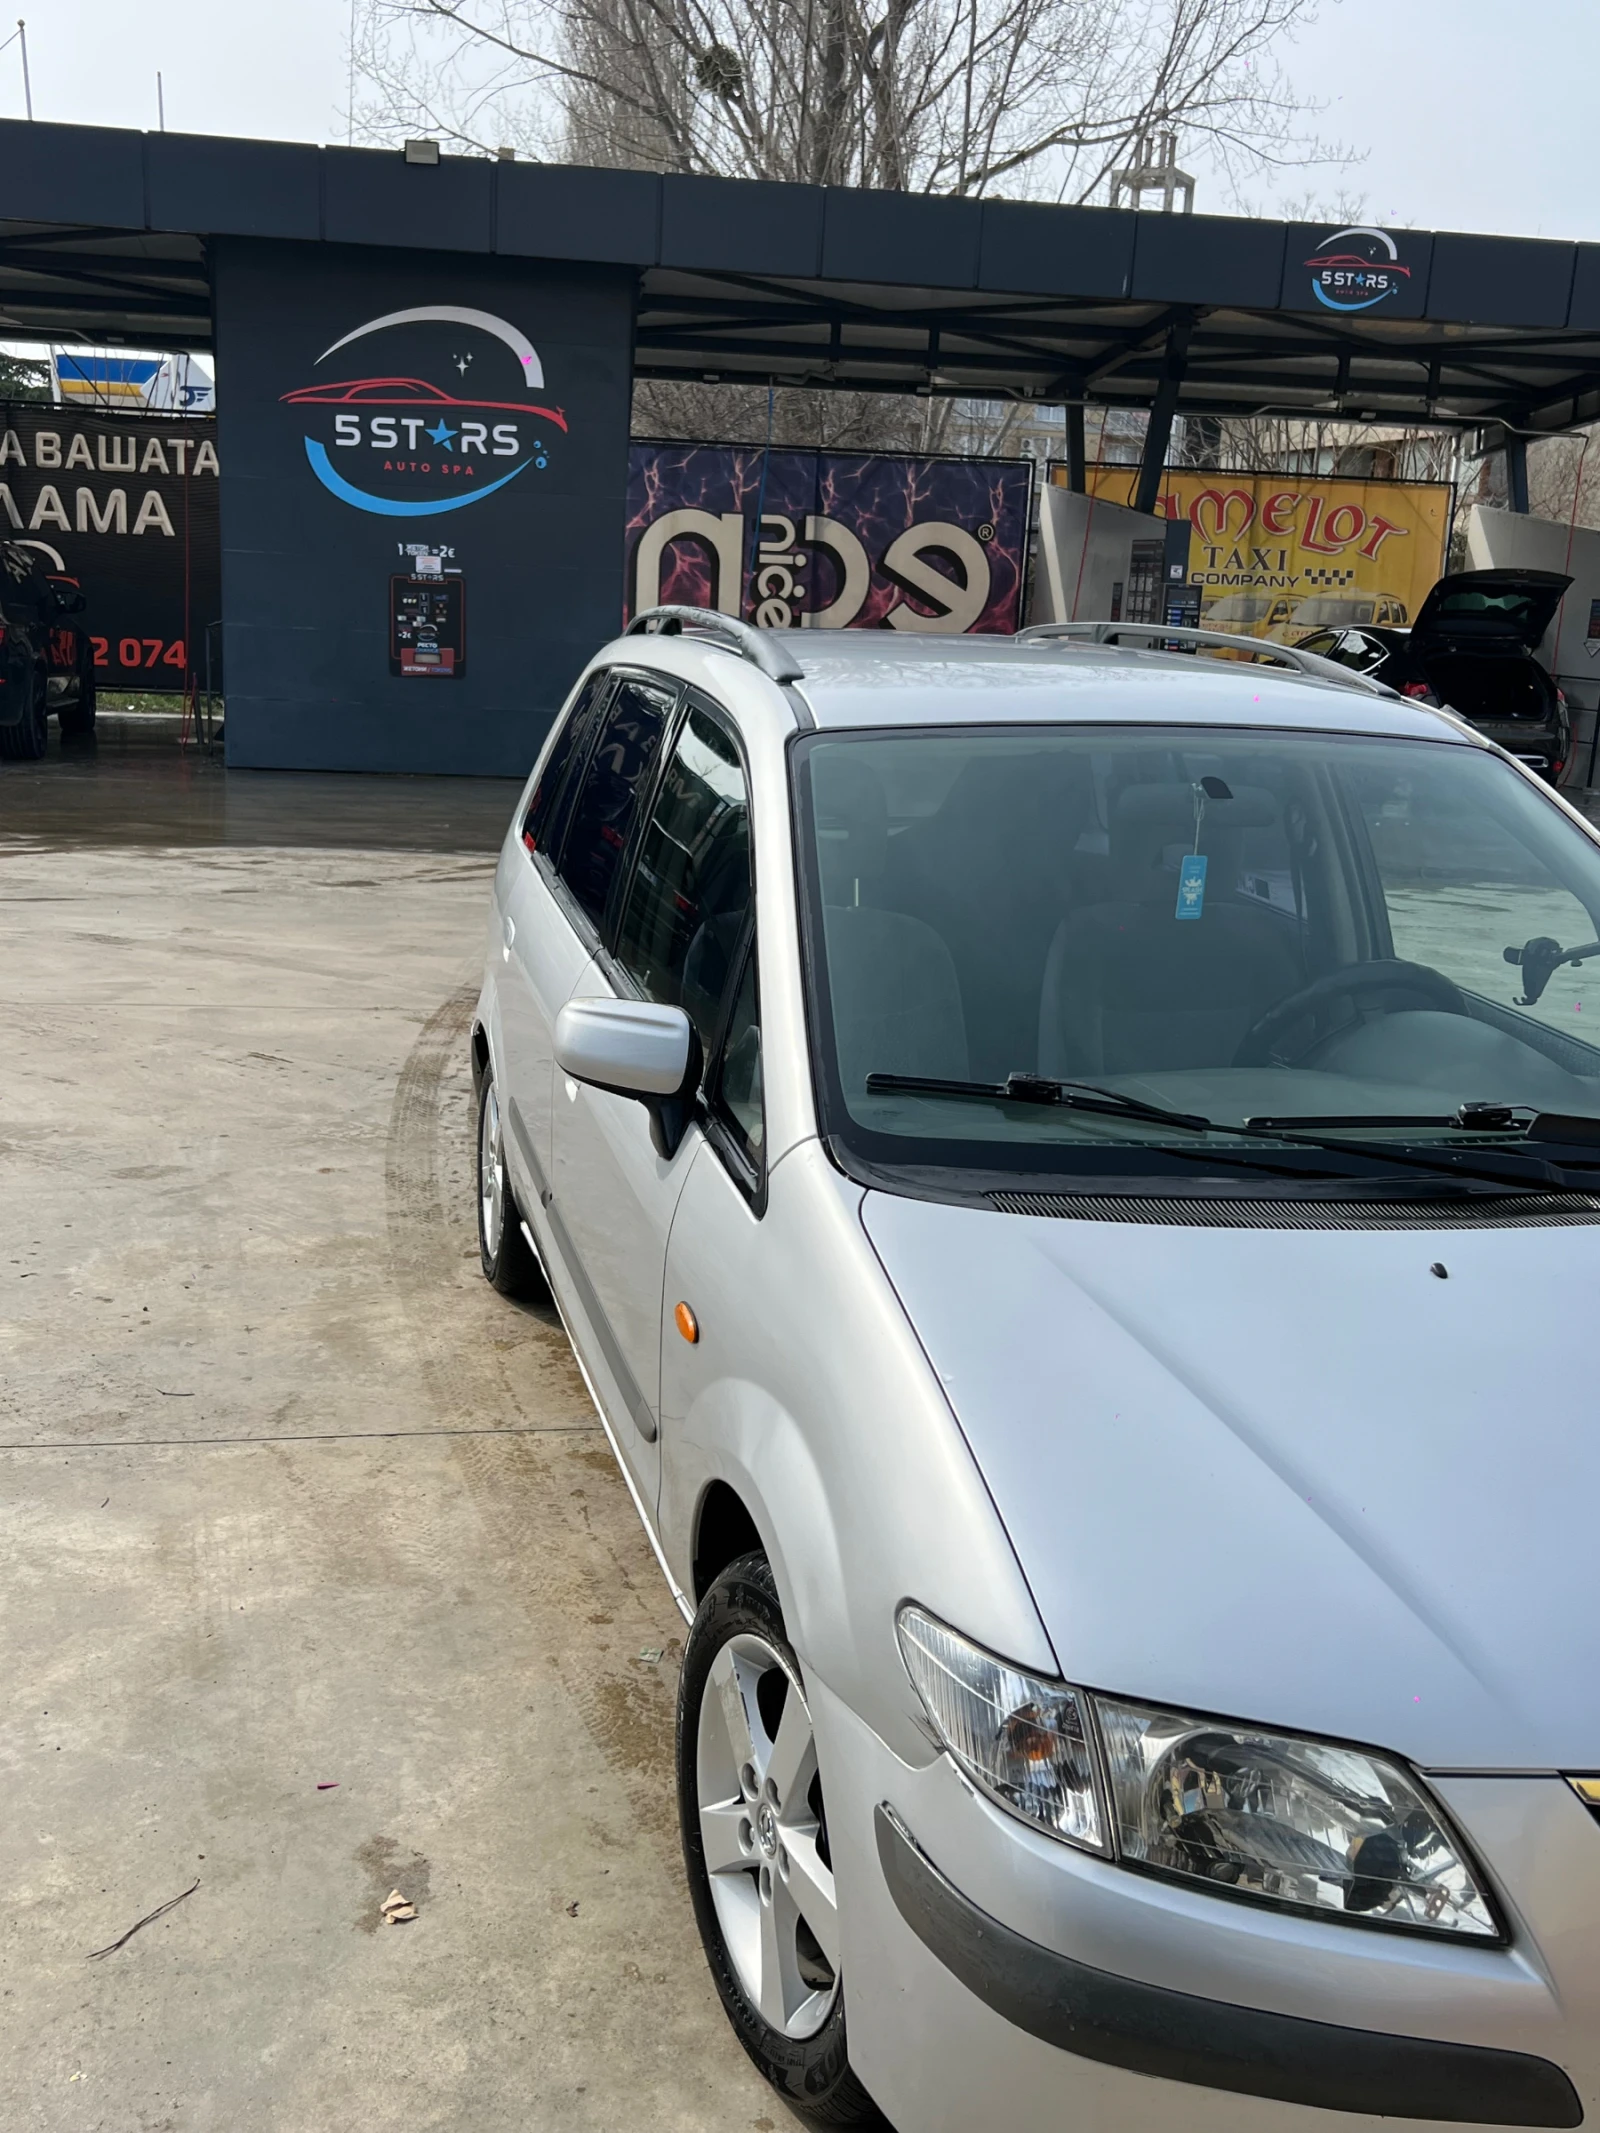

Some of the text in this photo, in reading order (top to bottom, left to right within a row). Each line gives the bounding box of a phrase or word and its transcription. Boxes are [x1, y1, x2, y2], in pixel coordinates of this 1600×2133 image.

[1321, 271, 1332, 285] 5
[335, 414, 362, 447] 5
[384, 461, 474, 476] AUTO SPA
[1203, 546, 1289, 572] TAXI
[1190, 572, 1300, 588] COMPANY
[119, 638, 187, 669] 074
